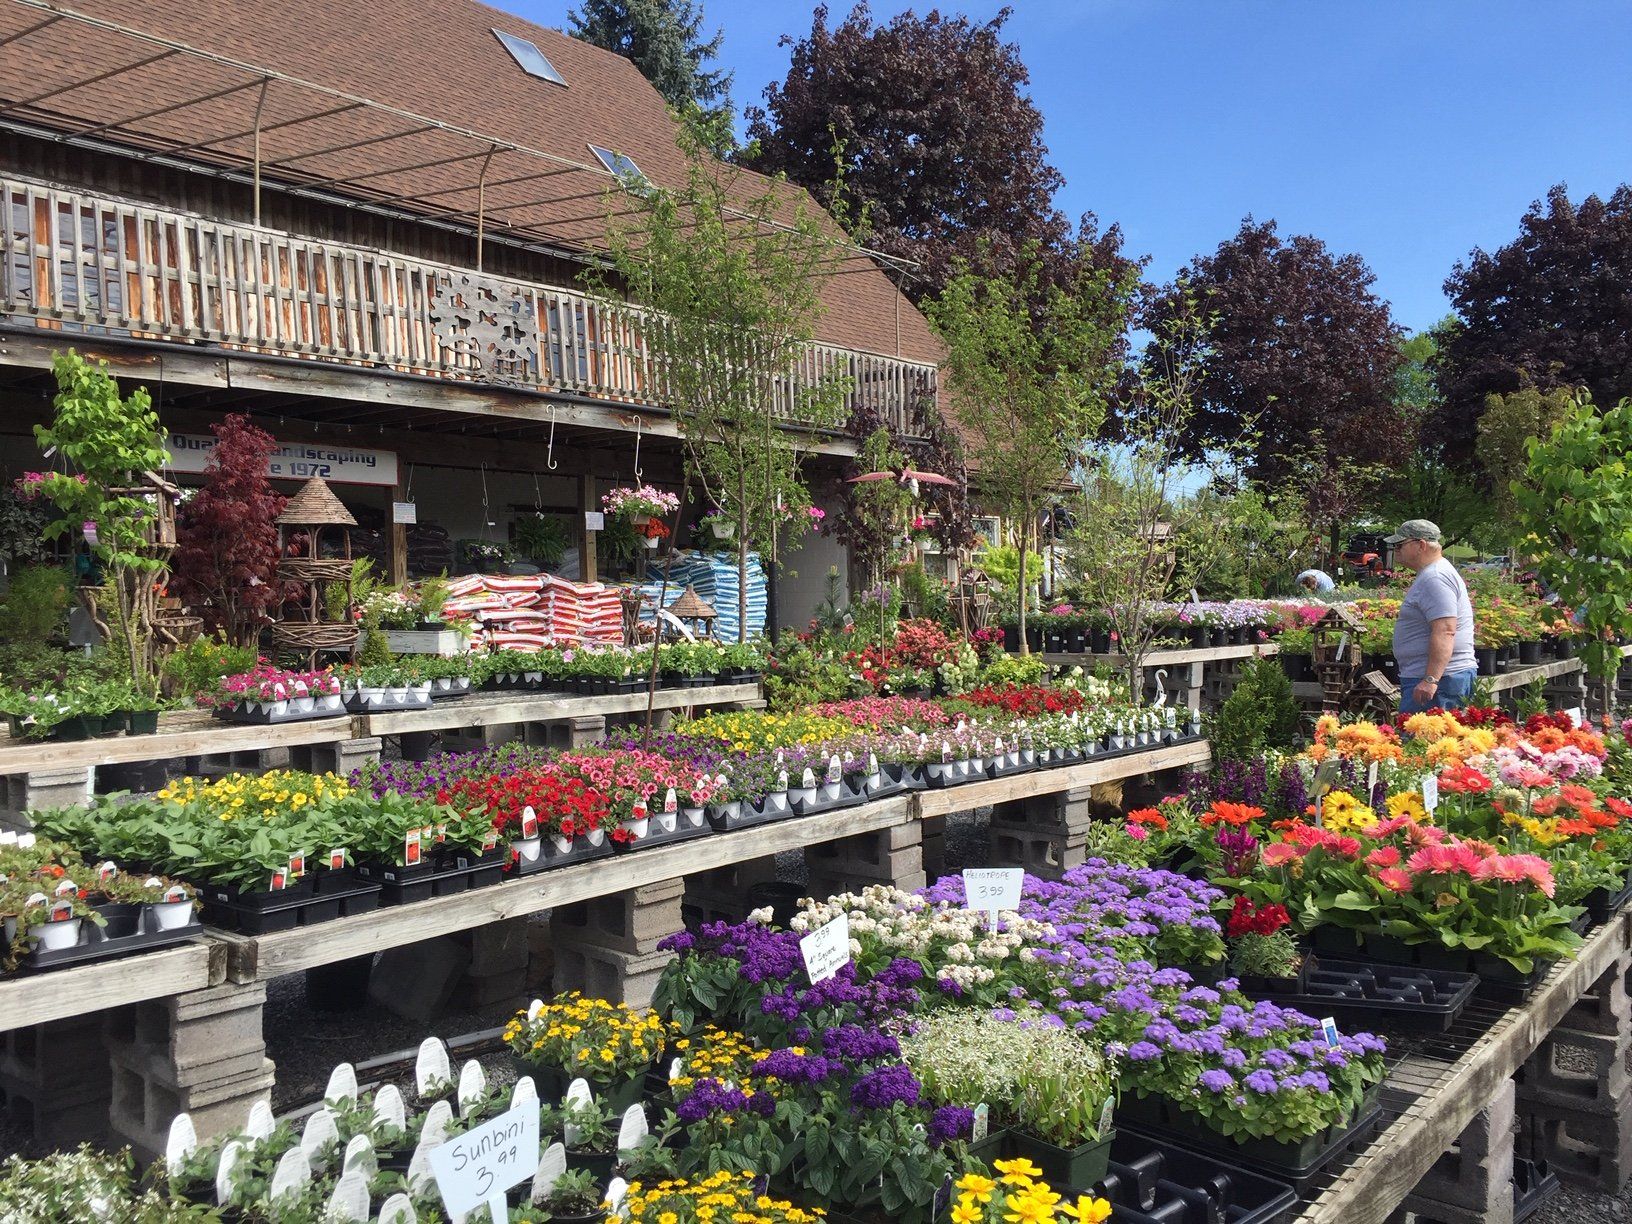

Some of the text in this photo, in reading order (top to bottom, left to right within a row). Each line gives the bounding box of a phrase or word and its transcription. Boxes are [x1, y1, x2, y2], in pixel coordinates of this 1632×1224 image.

[270, 445, 376, 468] andscaping
[290, 462, 330, 477] 1972
[452, 1115, 525, 1171] Sunbini
